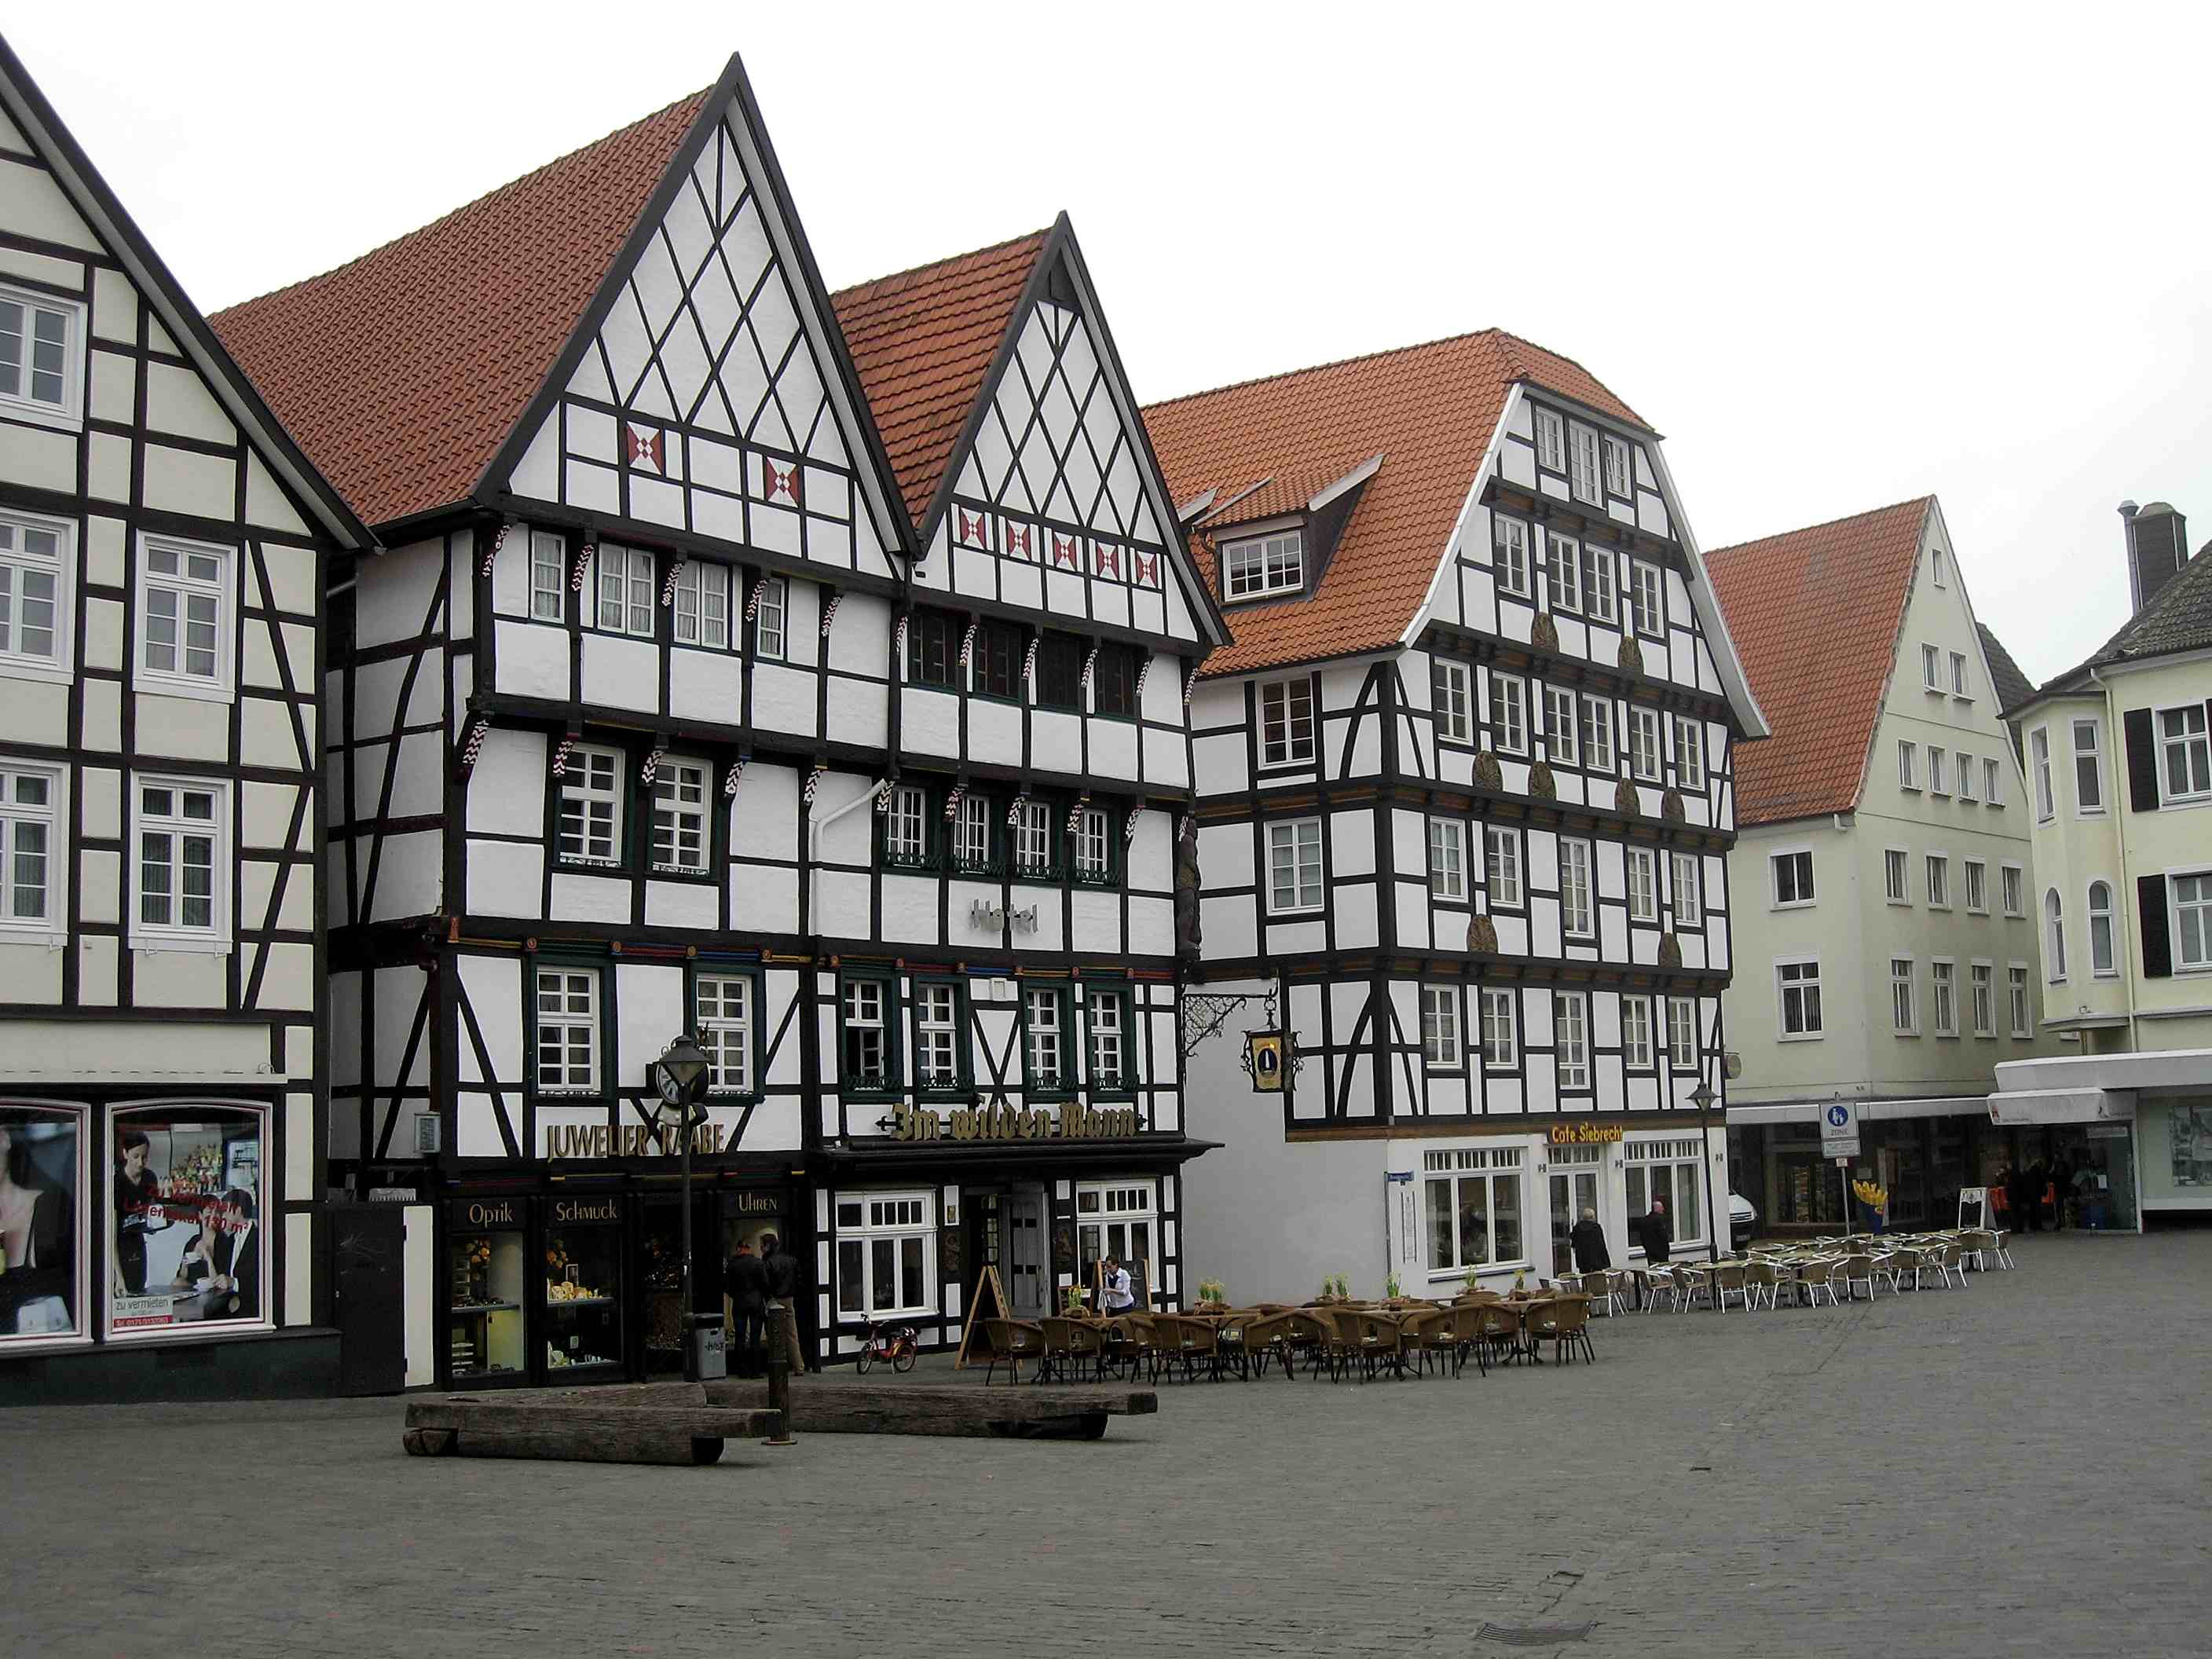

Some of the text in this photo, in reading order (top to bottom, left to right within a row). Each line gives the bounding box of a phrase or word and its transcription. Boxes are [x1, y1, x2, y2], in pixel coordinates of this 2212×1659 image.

[971, 899, 1038, 932] Hotel
[892, 1101, 1136, 1140] Im wilden Mann
[1579, 1122, 1622, 1142] Siebrecht
[547, 1124, 648, 1163] JUWELIER
